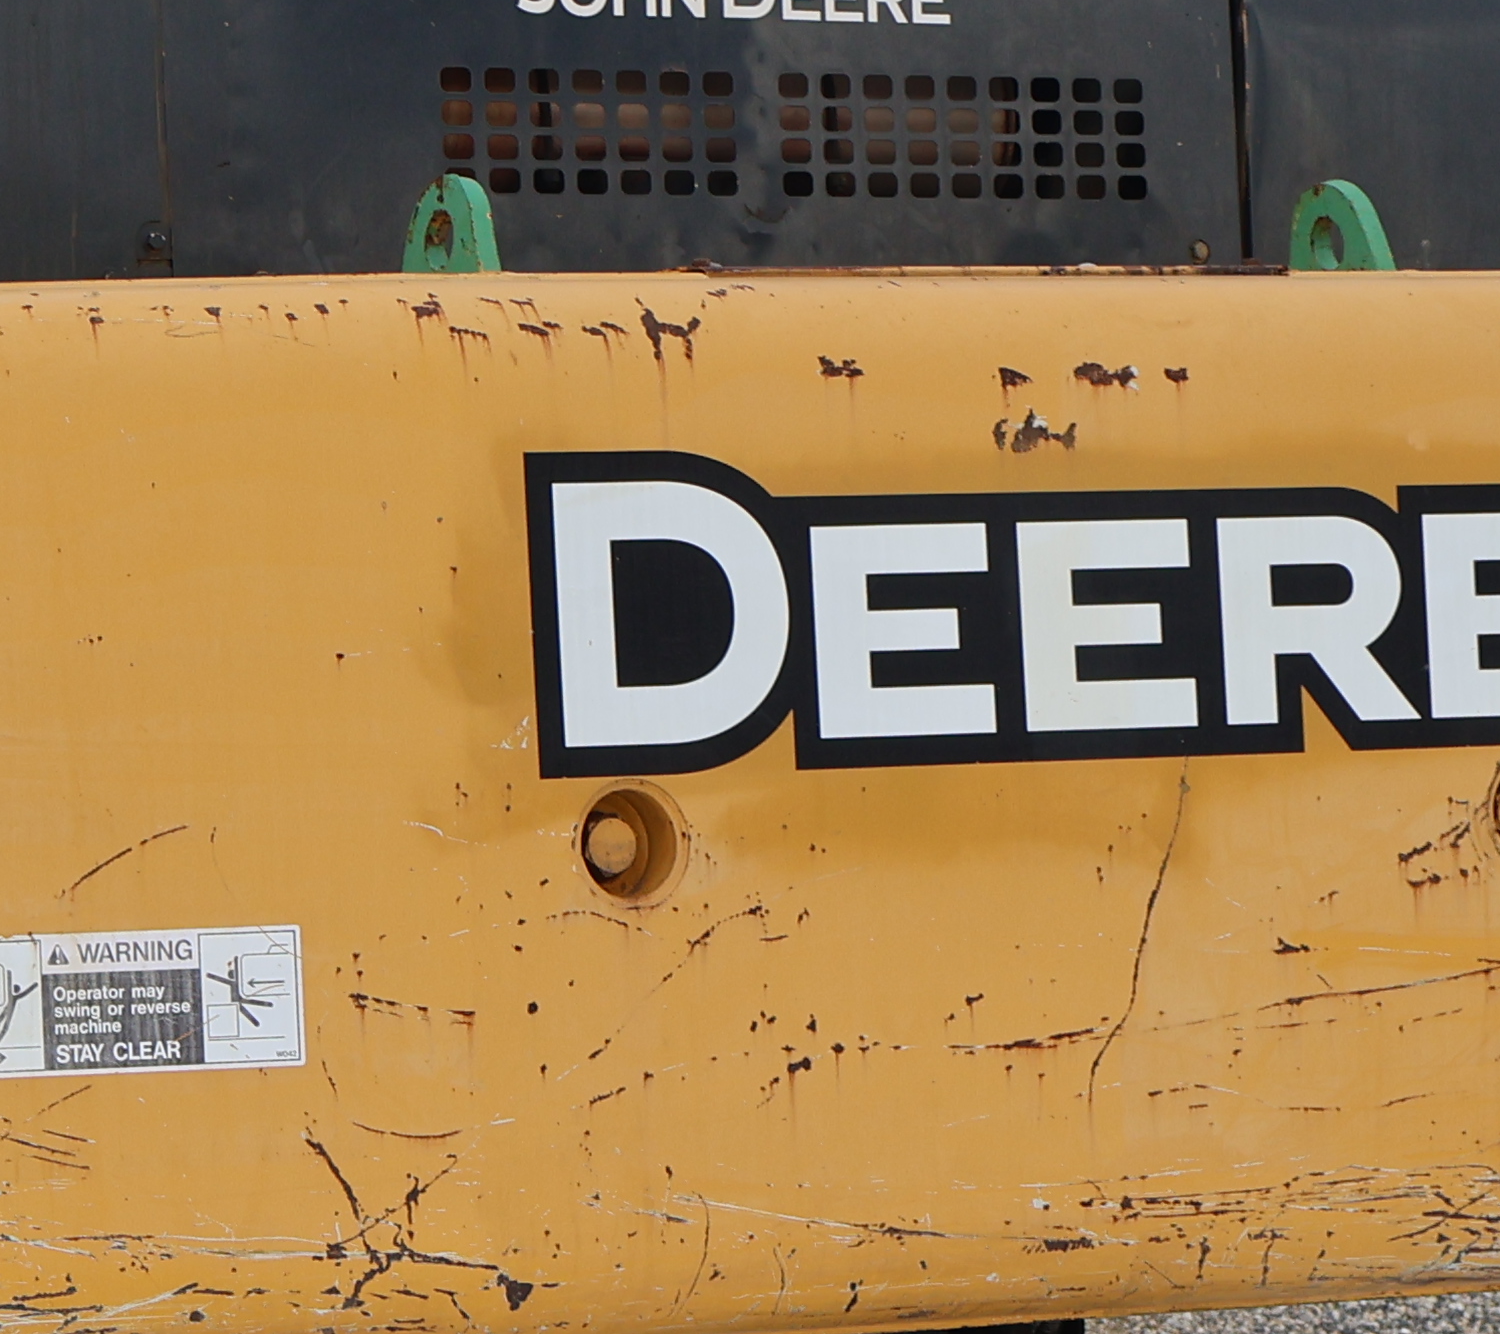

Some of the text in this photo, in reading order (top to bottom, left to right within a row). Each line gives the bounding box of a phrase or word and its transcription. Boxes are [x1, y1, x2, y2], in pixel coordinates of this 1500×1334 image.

[77, 939, 193, 963] WARNING
[53, 986, 165, 1004] Operator may
[54, 1002, 191, 1019] swing or reverse
[54, 1019, 123, 1035] machine
[56, 1040, 182, 1063] STAY CLEAR
